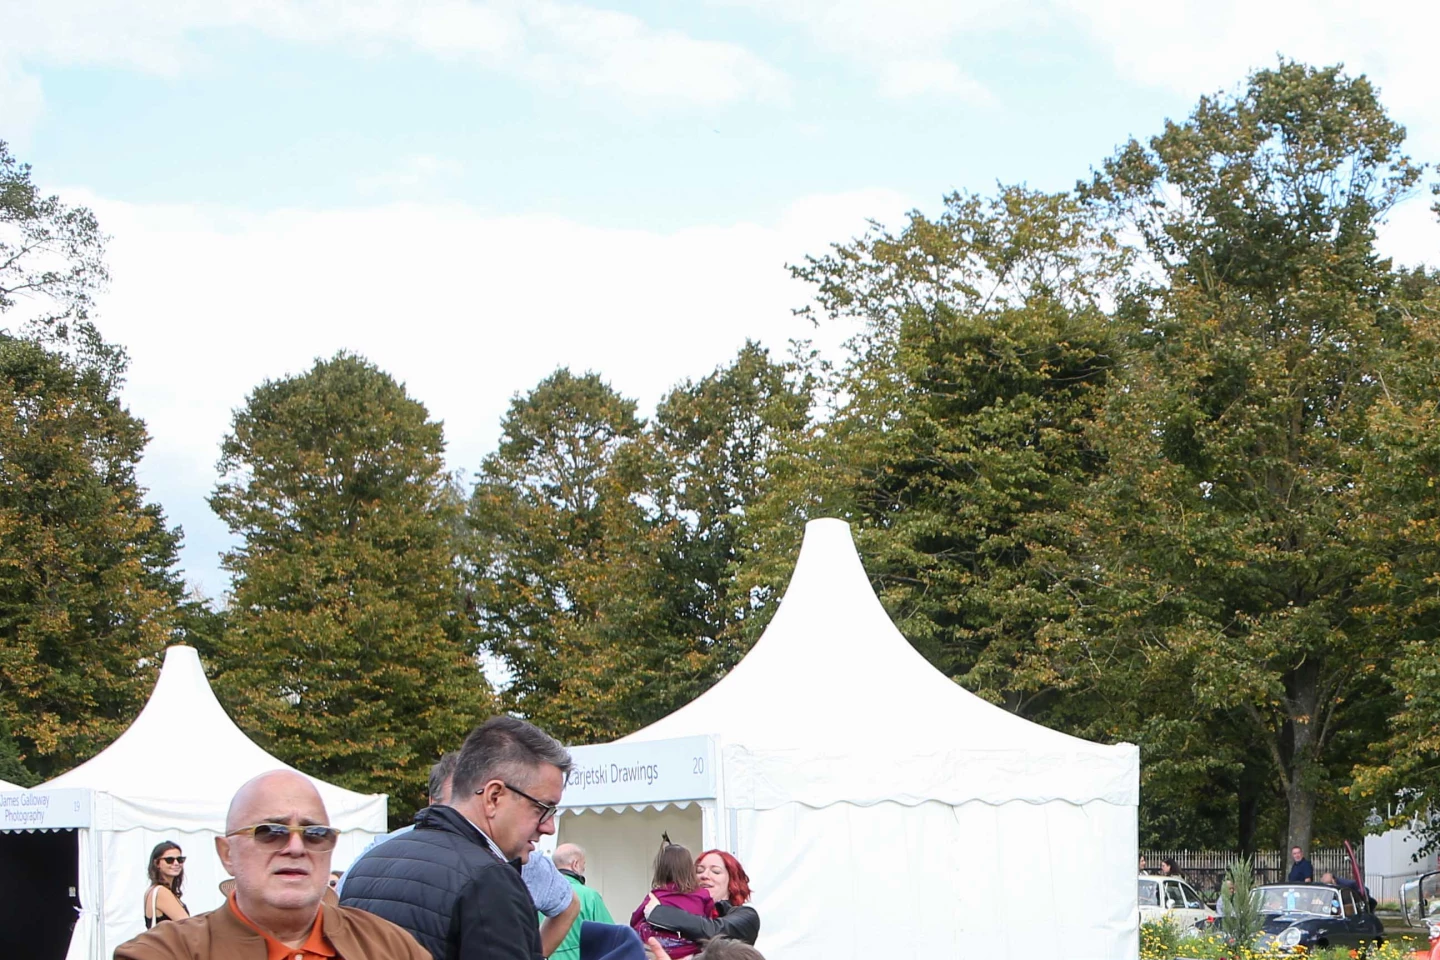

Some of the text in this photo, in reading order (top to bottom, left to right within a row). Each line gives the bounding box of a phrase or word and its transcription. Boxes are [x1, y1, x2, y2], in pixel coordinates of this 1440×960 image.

[610, 760, 659, 785] Drawings
[693, 756, 704, 775] 20
[21, 793, 50, 808] Galloway
[5, 809, 45, 825] Photography
